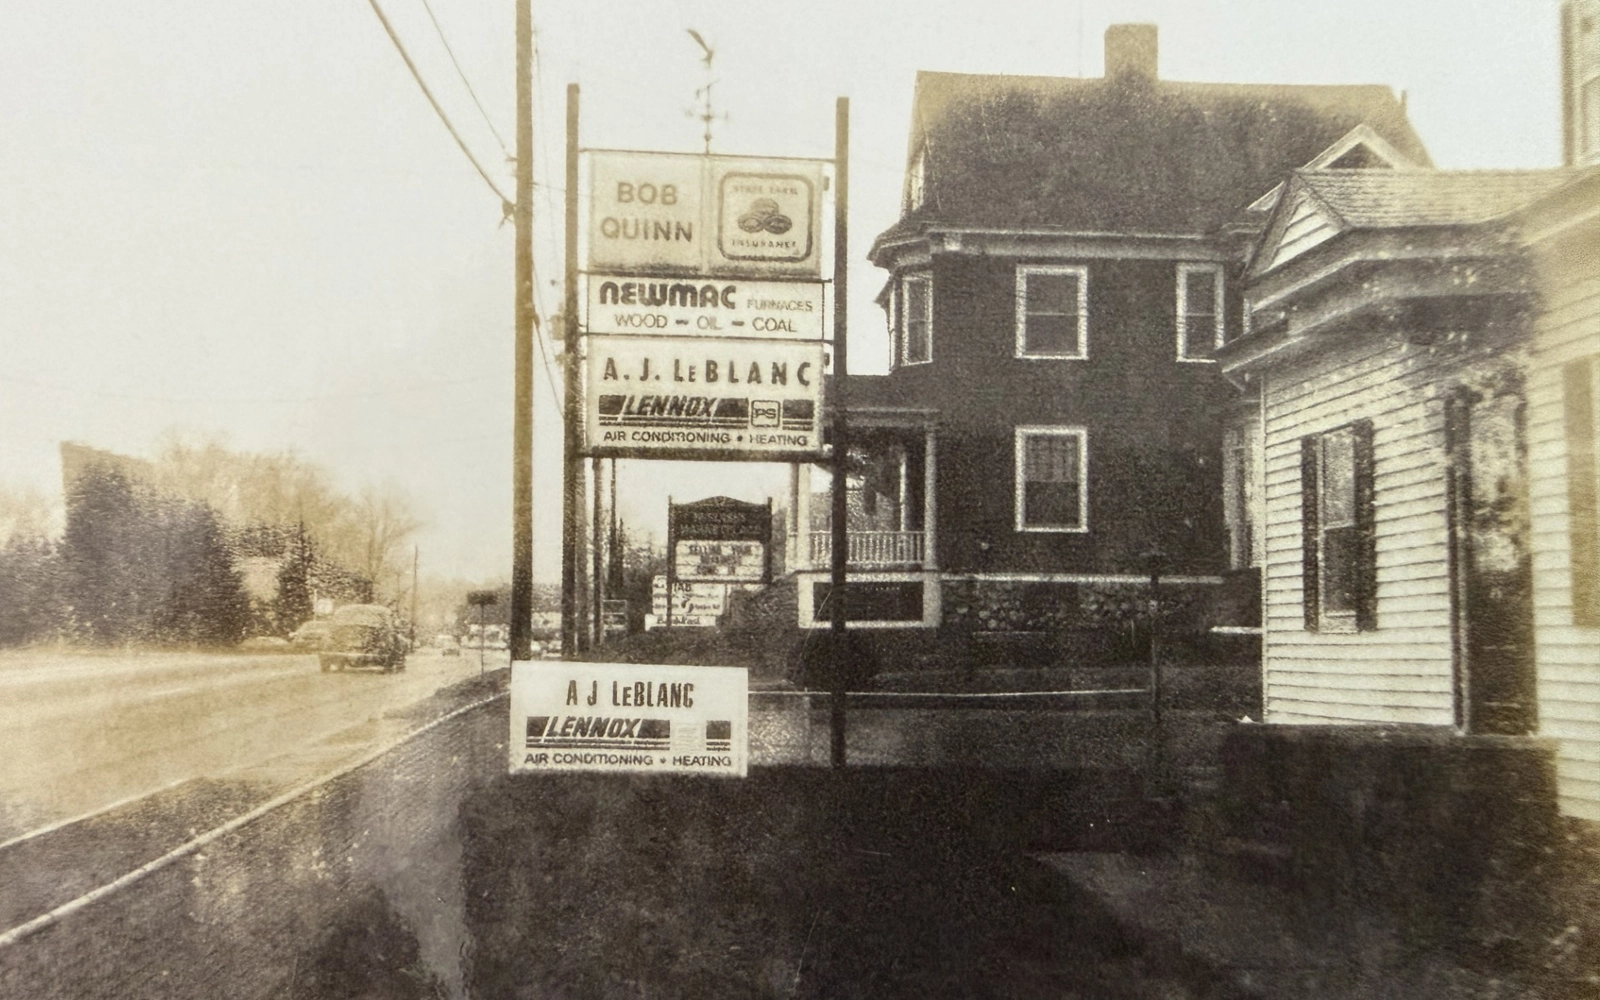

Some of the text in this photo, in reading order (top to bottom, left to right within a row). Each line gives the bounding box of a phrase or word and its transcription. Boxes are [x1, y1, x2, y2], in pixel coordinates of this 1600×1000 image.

[617, 182, 679, 206] BOB
[600, 216, 693, 242] QUINN
[746, 299, 813, 312] FURNACES
[614, 313, 799, 333] WOOD OIL COAL
[603, 357, 630, 381] A.
[639, 357, 661, 382] J.
[622, 395, 718, 417] LENNOX
[603, 430, 808, 447] AIR CONDITIONING HEATING
[566, 679, 578, 706] A
[587, 680, 598, 706] J
[546, 716, 641, 738] LENNOX
[524, 752, 732, 767] AIR CONDITIONING HEATING
